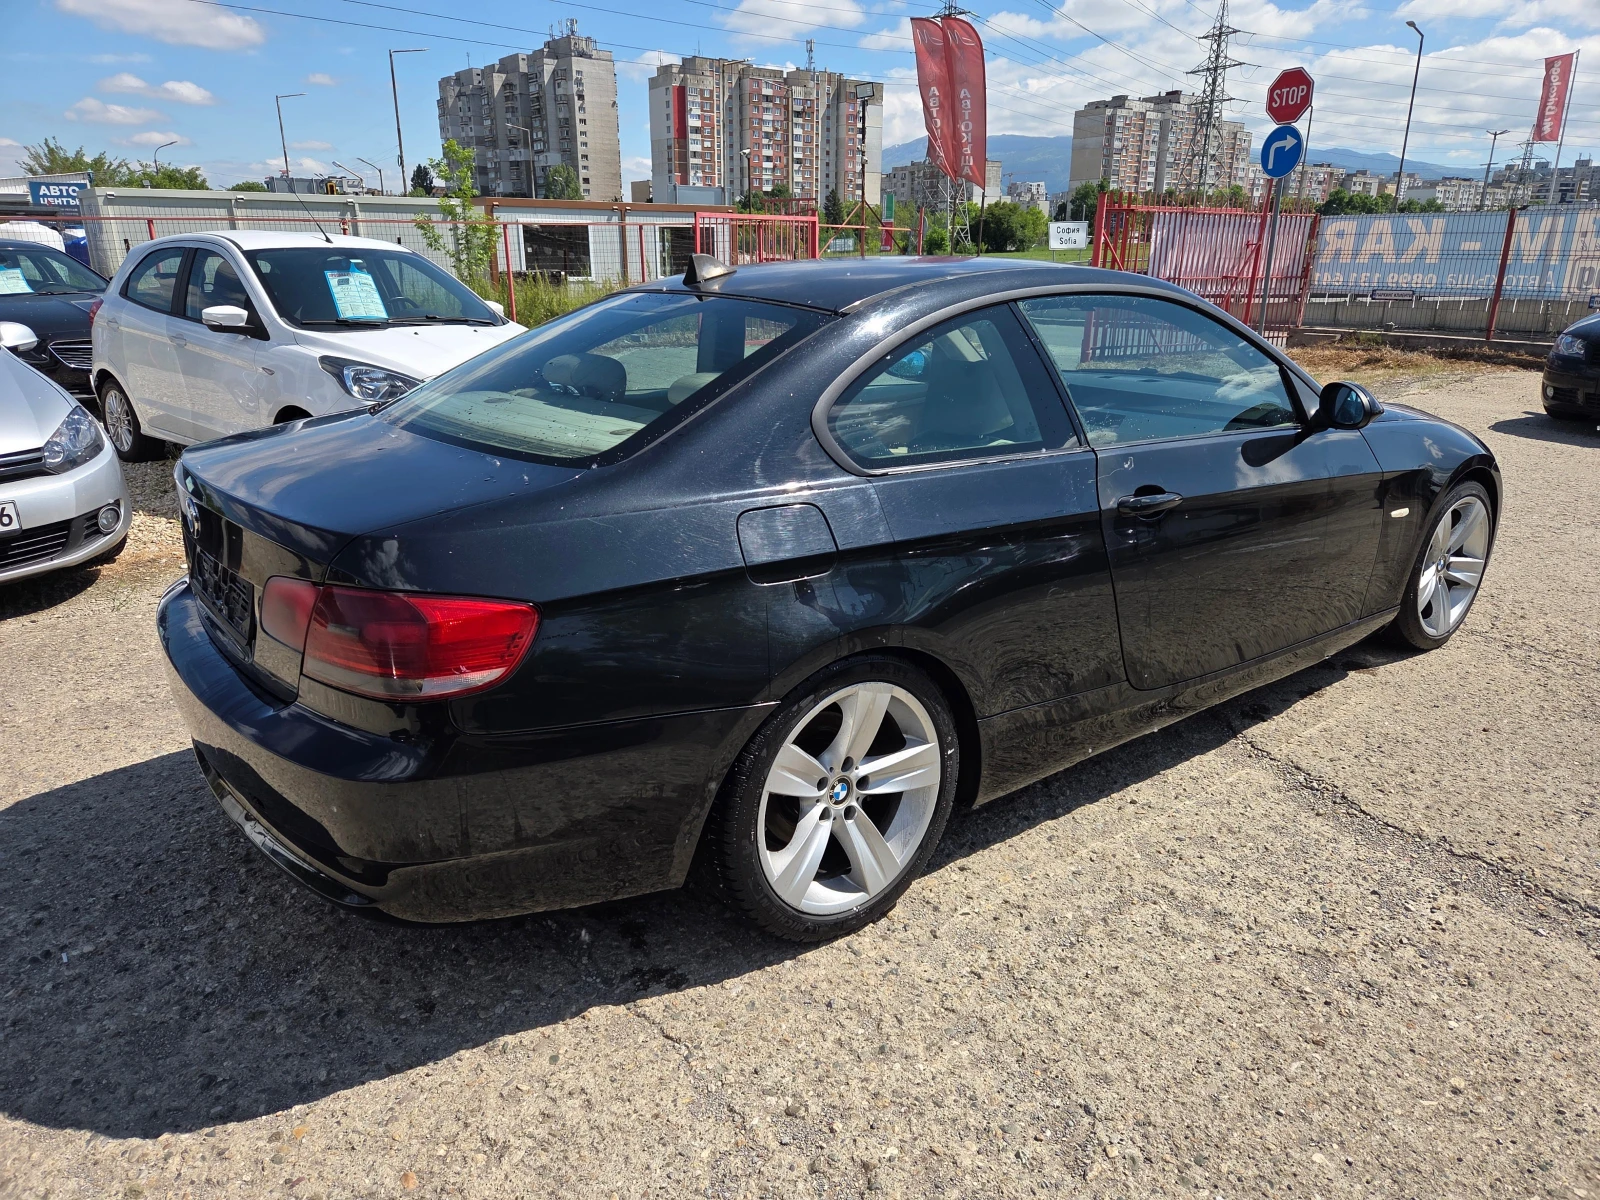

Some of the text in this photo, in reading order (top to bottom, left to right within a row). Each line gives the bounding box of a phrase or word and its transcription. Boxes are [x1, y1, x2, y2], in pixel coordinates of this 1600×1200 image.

[1271, 85, 1307, 107] STOP
[39, 186, 79, 196] АВТО
[1056, 226, 1080, 235] София
[1060, 237, 1077, 245] Sofia
[0, 506, 13, 527] 6
